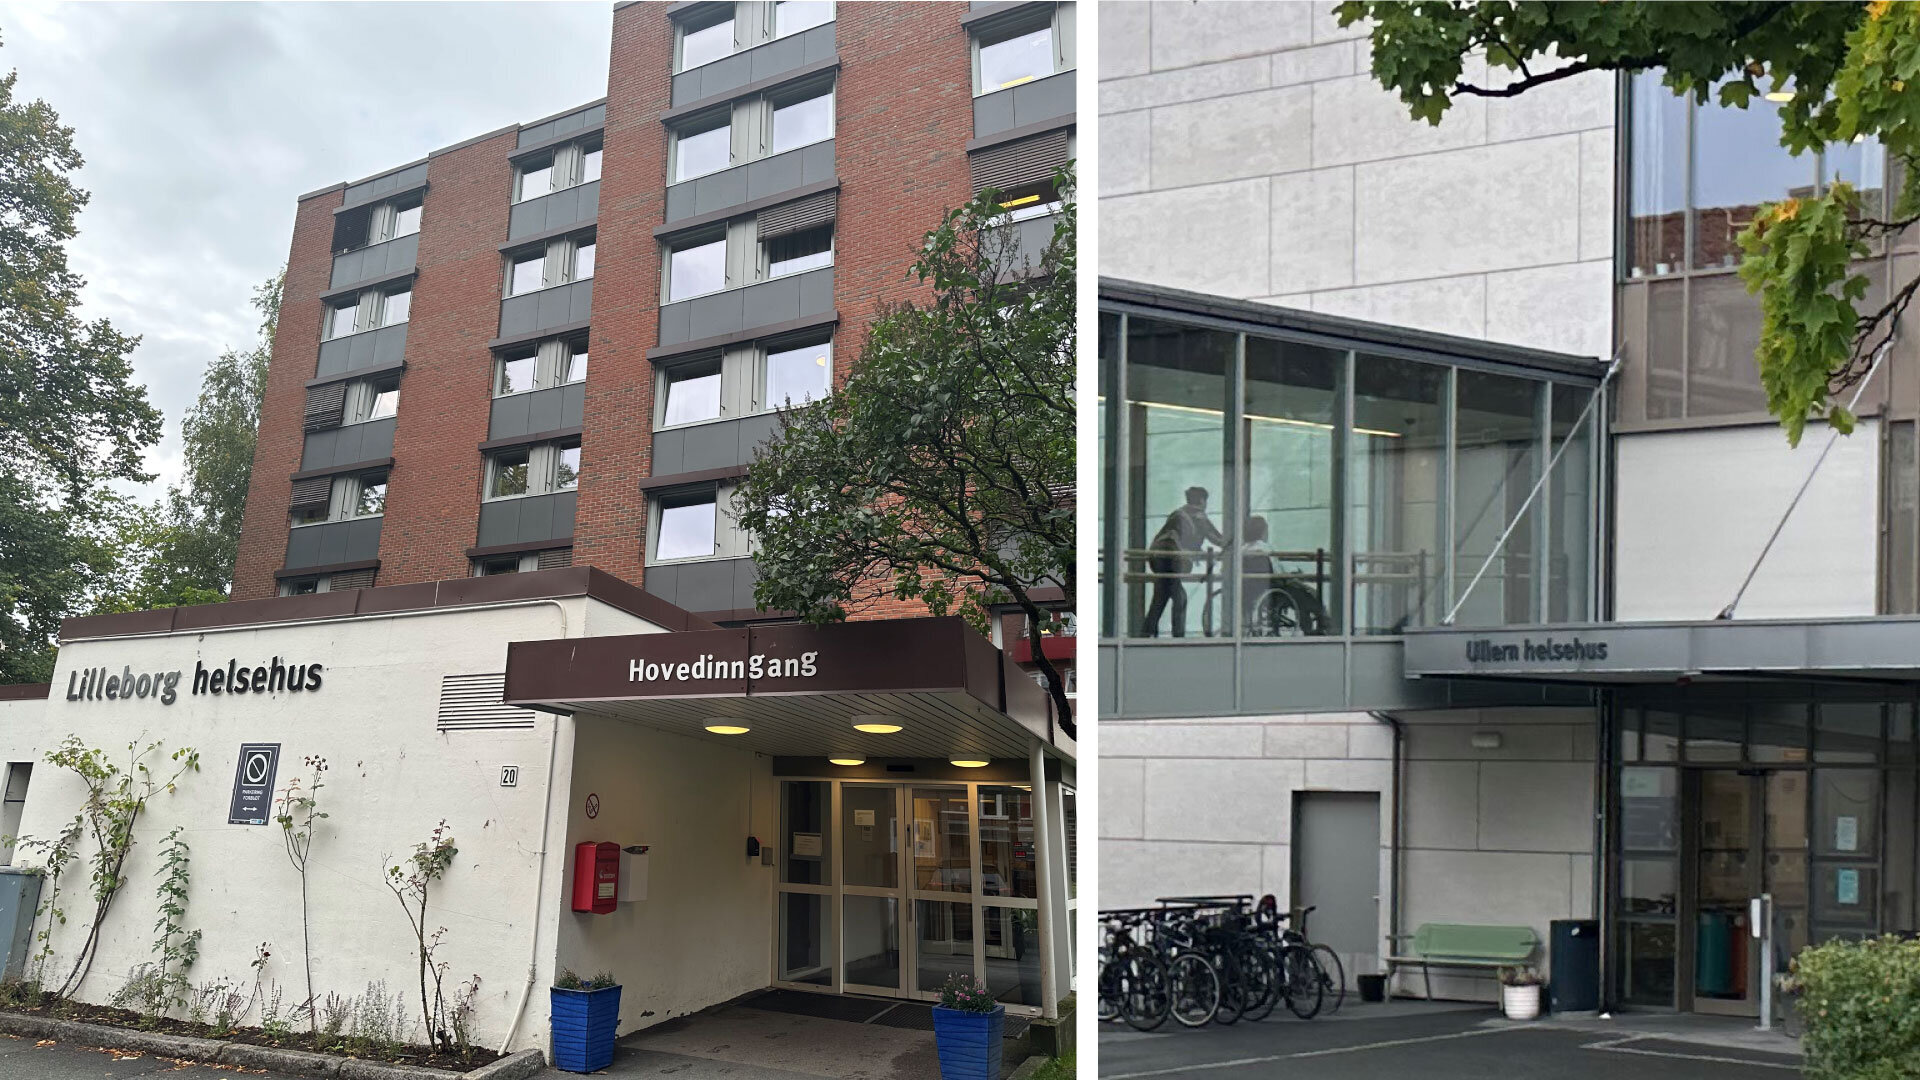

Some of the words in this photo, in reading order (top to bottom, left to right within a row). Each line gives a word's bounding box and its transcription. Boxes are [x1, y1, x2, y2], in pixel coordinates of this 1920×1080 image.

[1466, 639, 1519, 662] Ullern
[1523, 637, 1608, 662] helsehus
[629, 650, 818, 682] Hovedinngang
[66, 665, 181, 705] Lilleborg
[192, 656, 323, 695] helsehus
[503, 769, 515, 783] 20
